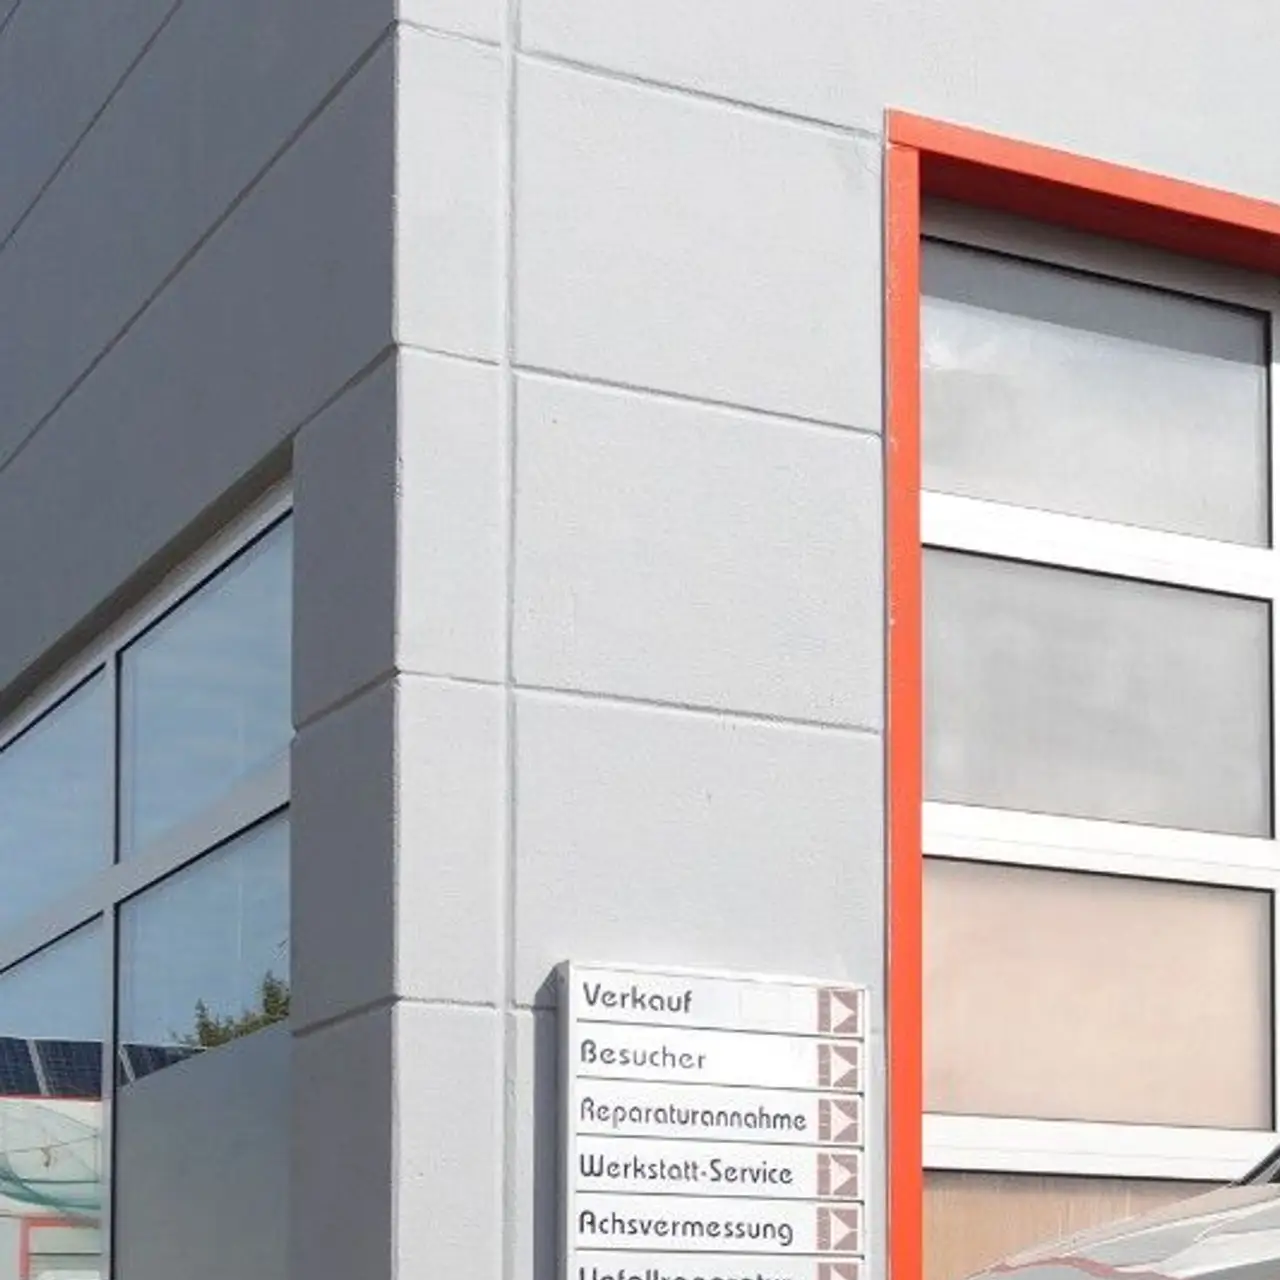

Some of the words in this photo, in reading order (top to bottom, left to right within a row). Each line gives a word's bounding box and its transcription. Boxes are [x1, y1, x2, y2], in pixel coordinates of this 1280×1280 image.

[582, 982, 692, 1014] Verkauf
[580, 1038, 706, 1070] Besucher
[580, 1096, 808, 1132] Reparaturannahme
[579, 1153, 794, 1185] Werkstatt-Service
[578, 1209, 795, 1247] Achsvermessung
